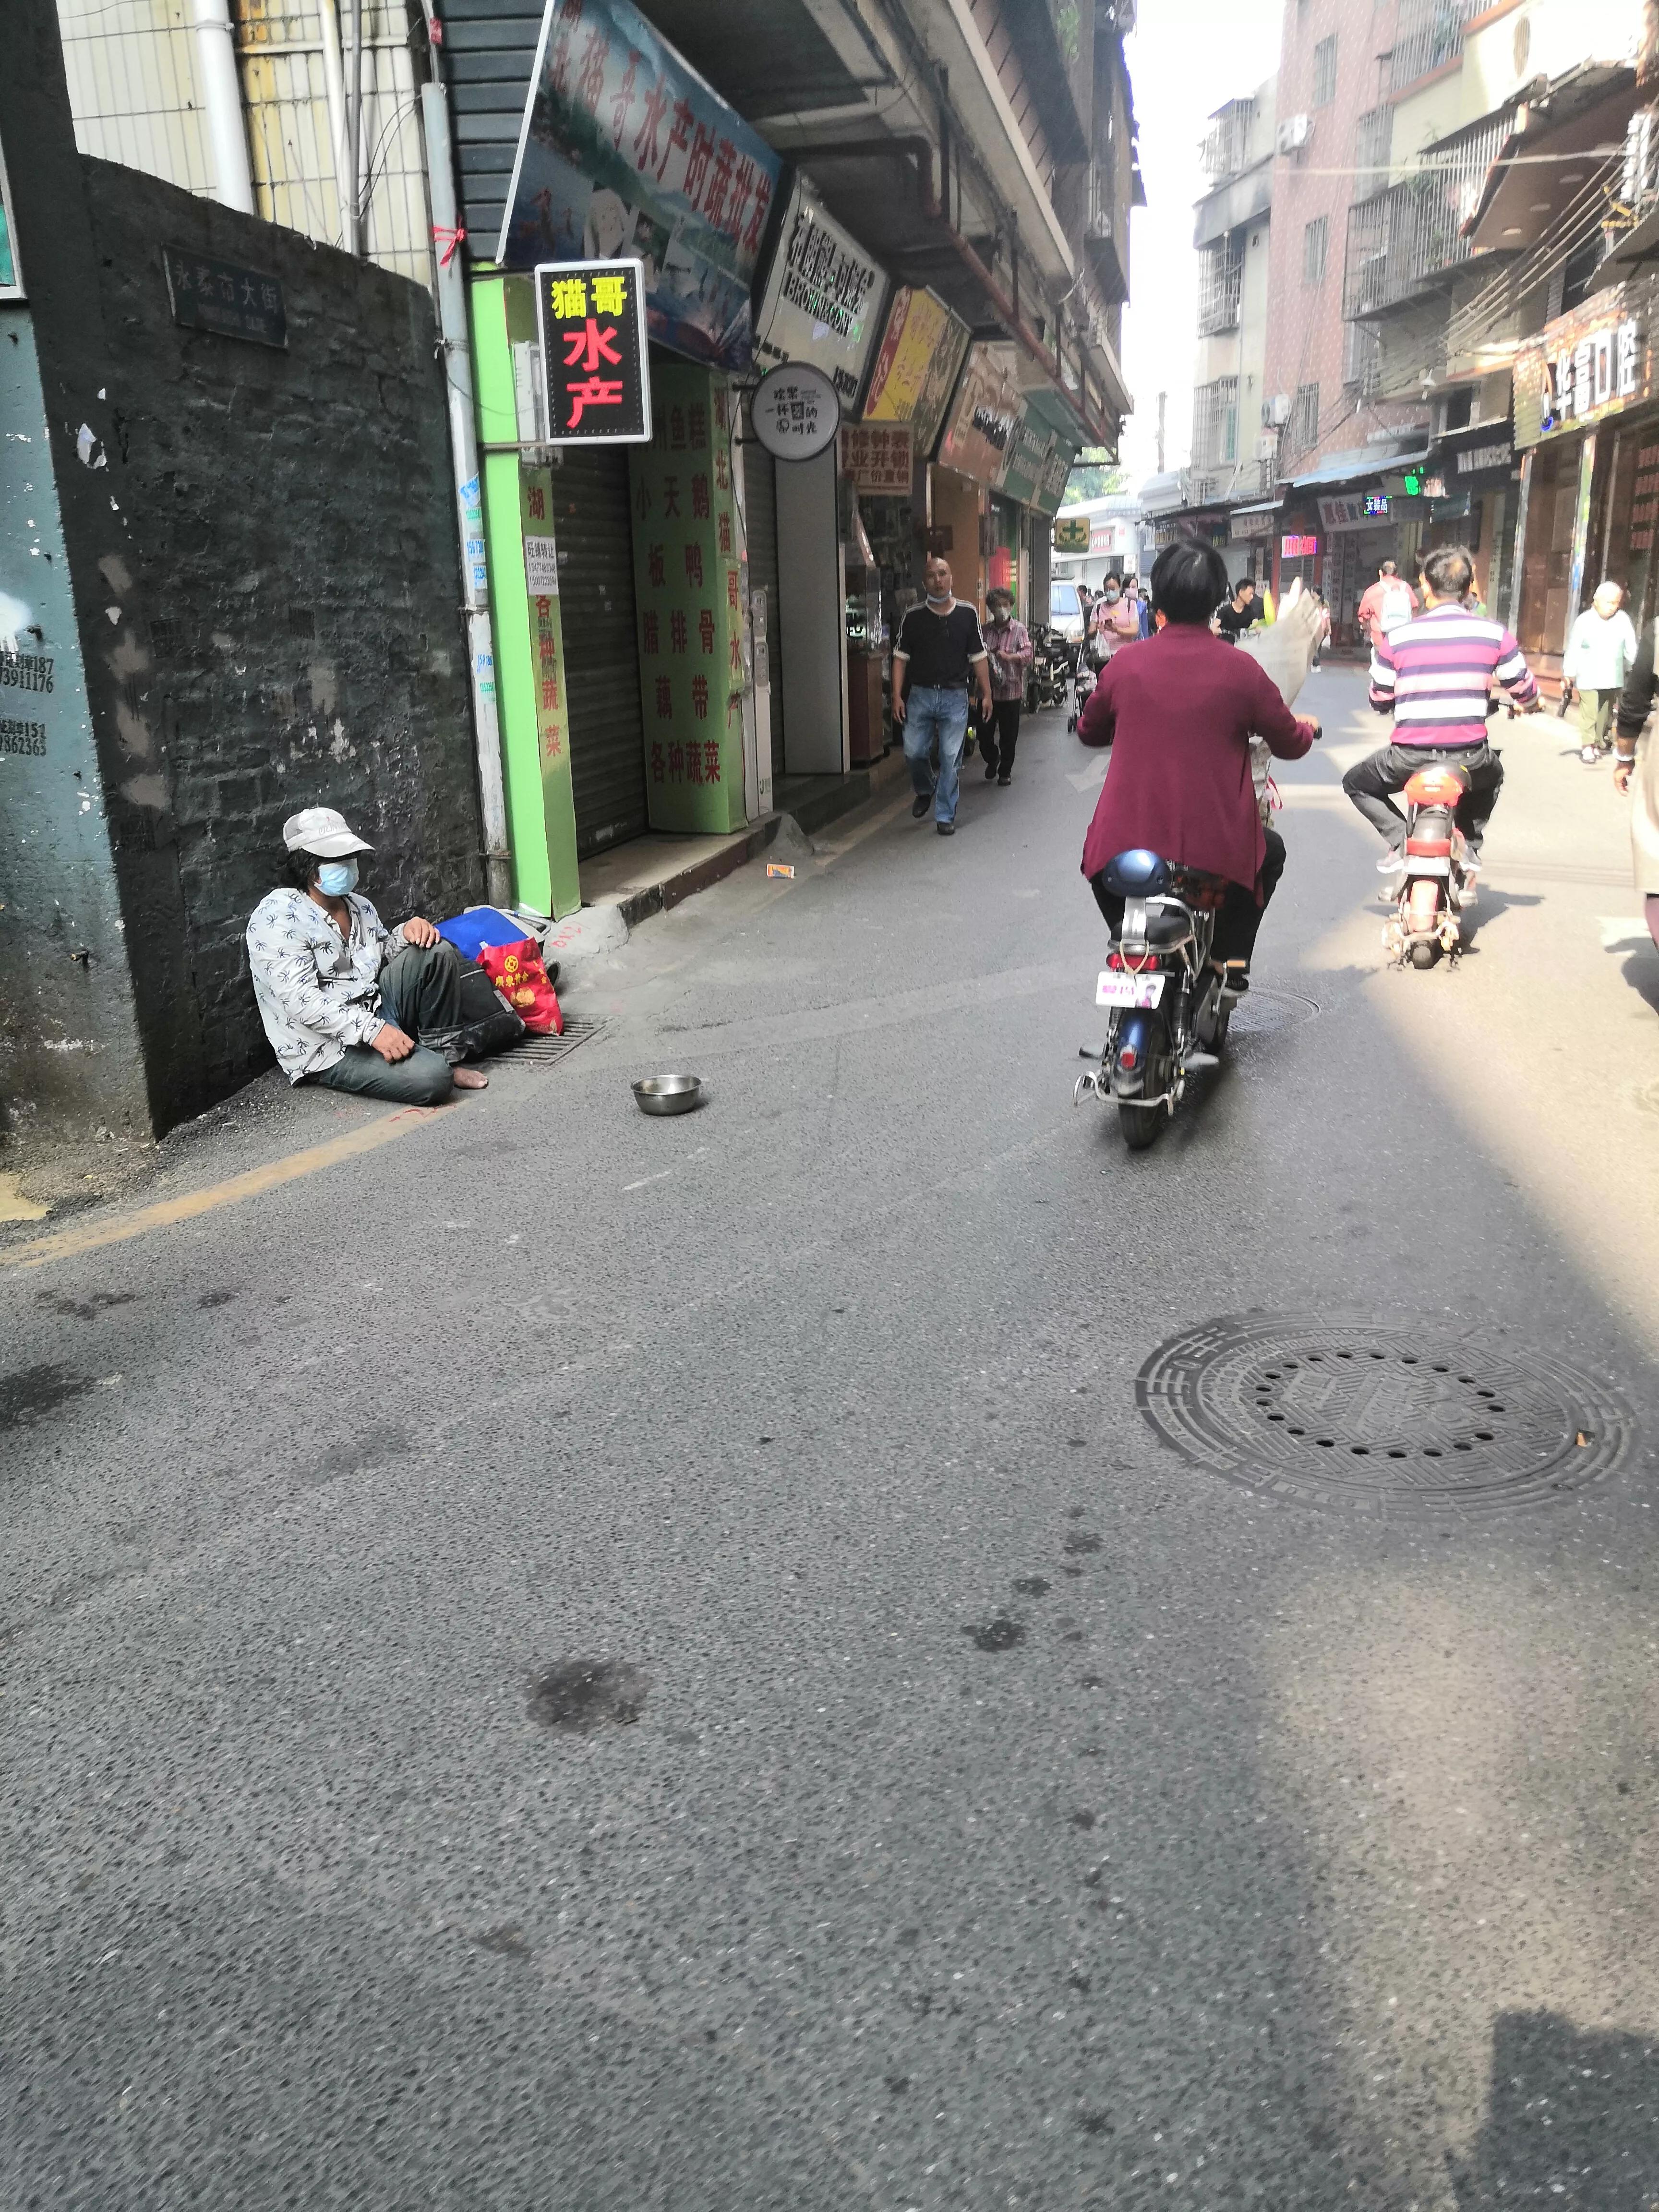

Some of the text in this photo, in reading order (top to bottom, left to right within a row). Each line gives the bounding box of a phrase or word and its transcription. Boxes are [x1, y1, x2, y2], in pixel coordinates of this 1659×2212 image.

[551, 276, 627, 319] 猫哥
[563, 318, 623, 429] 水产
[1554, 317, 1641, 422] 华富口腔
[651, 740, 721, 784] 各种蔬菜
